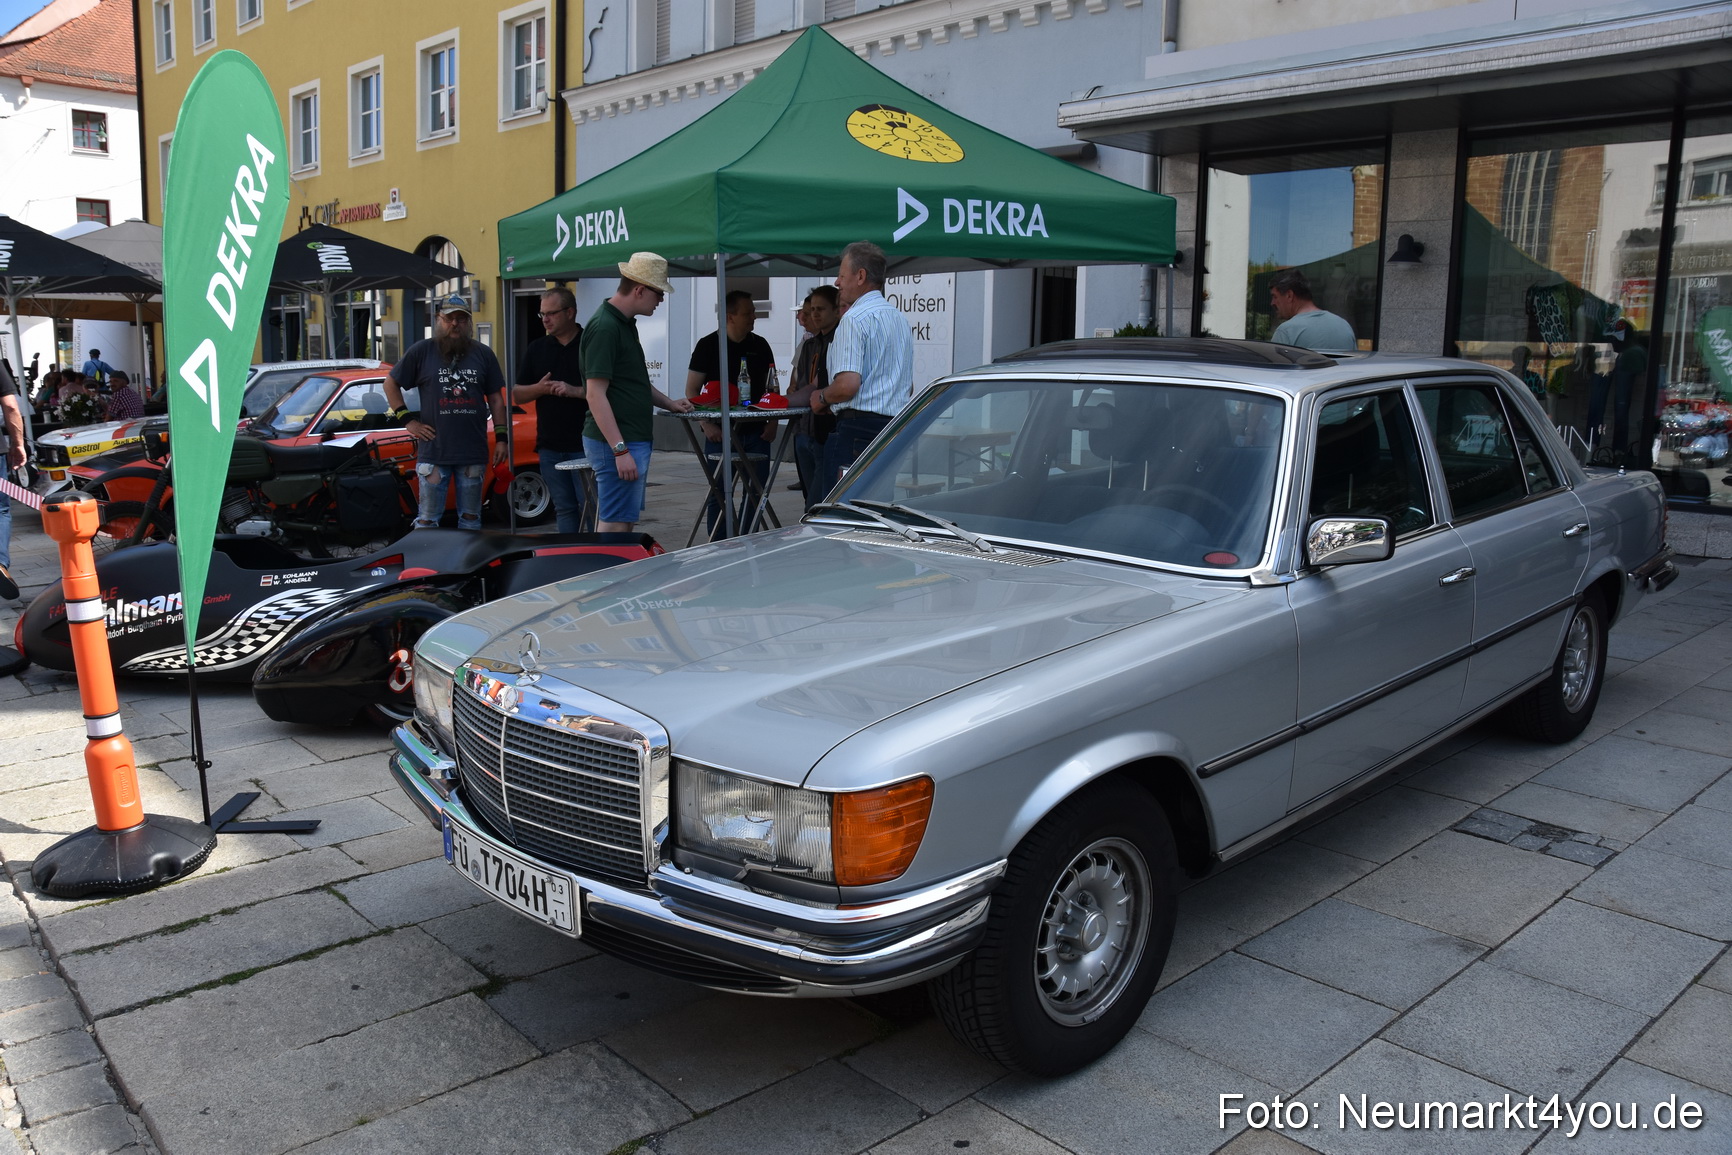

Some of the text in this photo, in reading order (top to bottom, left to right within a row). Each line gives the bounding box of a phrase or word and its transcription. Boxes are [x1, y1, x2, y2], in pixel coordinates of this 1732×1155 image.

[314, 198, 339, 225] CAFÉ
[943, 198, 1050, 238] DEKRA
[206, 133, 275, 332] DEKRA
[575, 206, 629, 249] DEKRA
[71, 443, 100, 455] Castrol
[283, 571, 318, 579] KOHLMANN
[204, 594, 231, 604] GmbH
[107, 627, 125, 639] ltdorf
[452, 827, 469, 872] FÜ
[551, 882, 564, 895] 03
[554, 909, 566, 922] 11
